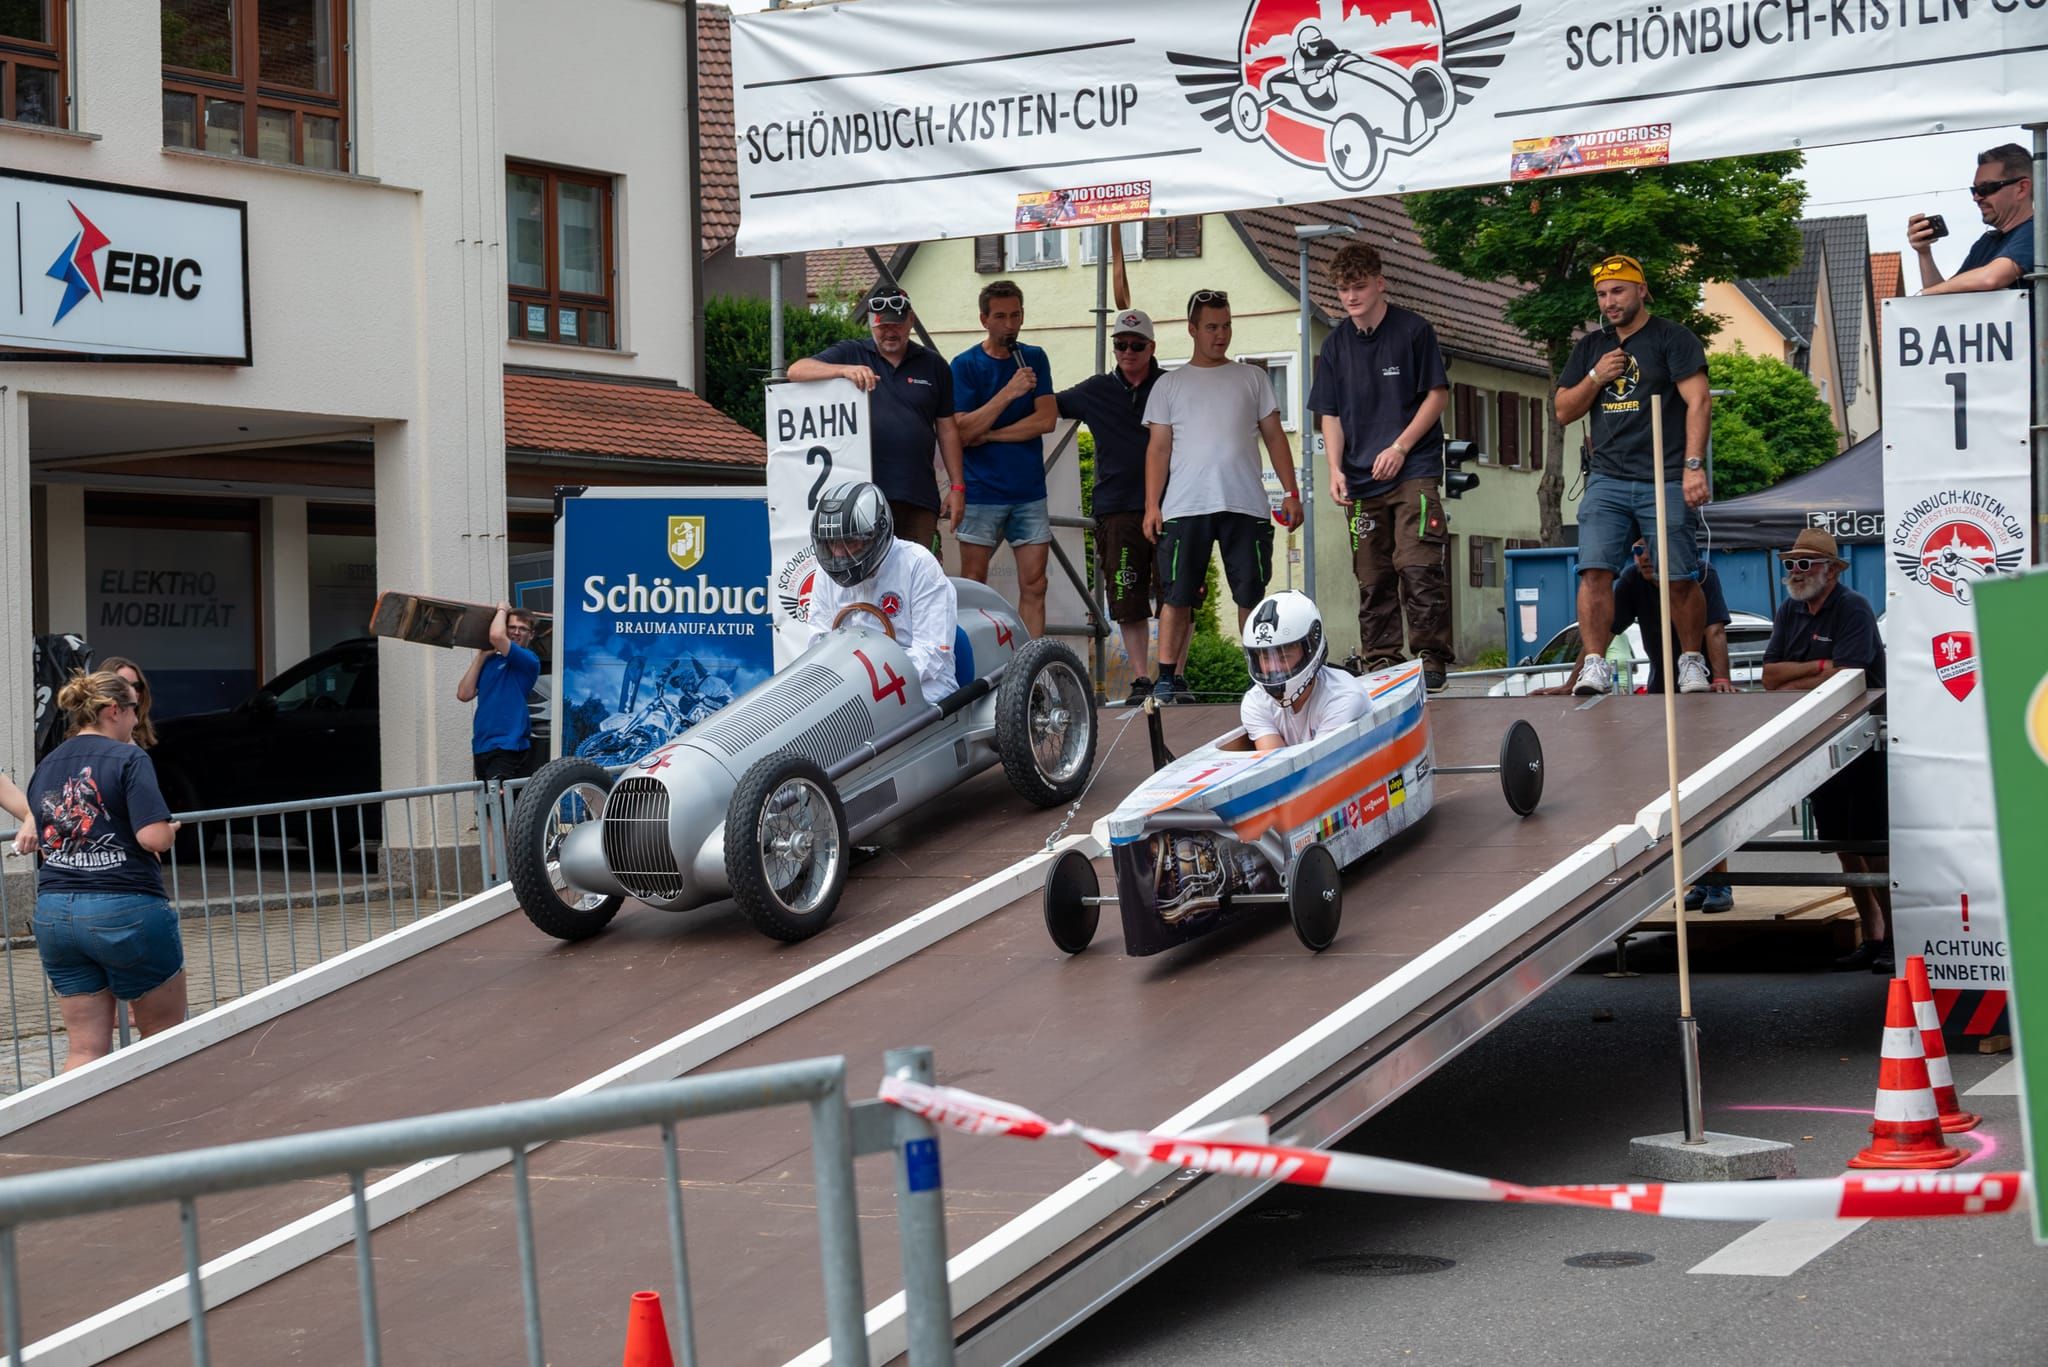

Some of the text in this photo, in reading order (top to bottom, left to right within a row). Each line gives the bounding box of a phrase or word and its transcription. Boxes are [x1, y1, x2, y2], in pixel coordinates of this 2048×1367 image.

[746, 82, 1138, 165] SCHÖNBUCH-KISTEN-CUP
[1574, 124, 1670, 147] MOTOCROSS
[1644, 143, 1668, 153] 2025
[1068, 181, 1151, 202] MOTOCROSS
[1130, 199, 1149, 208] 2025
[103, 250, 202, 301] EBIC
[1899, 321, 2013, 367] BAHN
[778, 402, 857, 442] BAHN
[1602, 401, 1639, 411] TWISTER
[1945, 372, 1967, 450] 1
[806, 445, 832, 510] 2
[1893, 490, 2024, 546] SCHÖNBUCH-KISTEN-CUP
[1945, 506, 2010, 545] HOLZGERLINGEN
[100, 568, 217, 596] ELEKTRO
[101, 597, 236, 629] MOBILITÄT
[615, 621, 755, 635] BRAUMANUFAKTUR
[970, 608, 1015, 651] 4
[853, 649, 906, 706] 4
[1926, 964, 2011, 982] ENNBETRI
